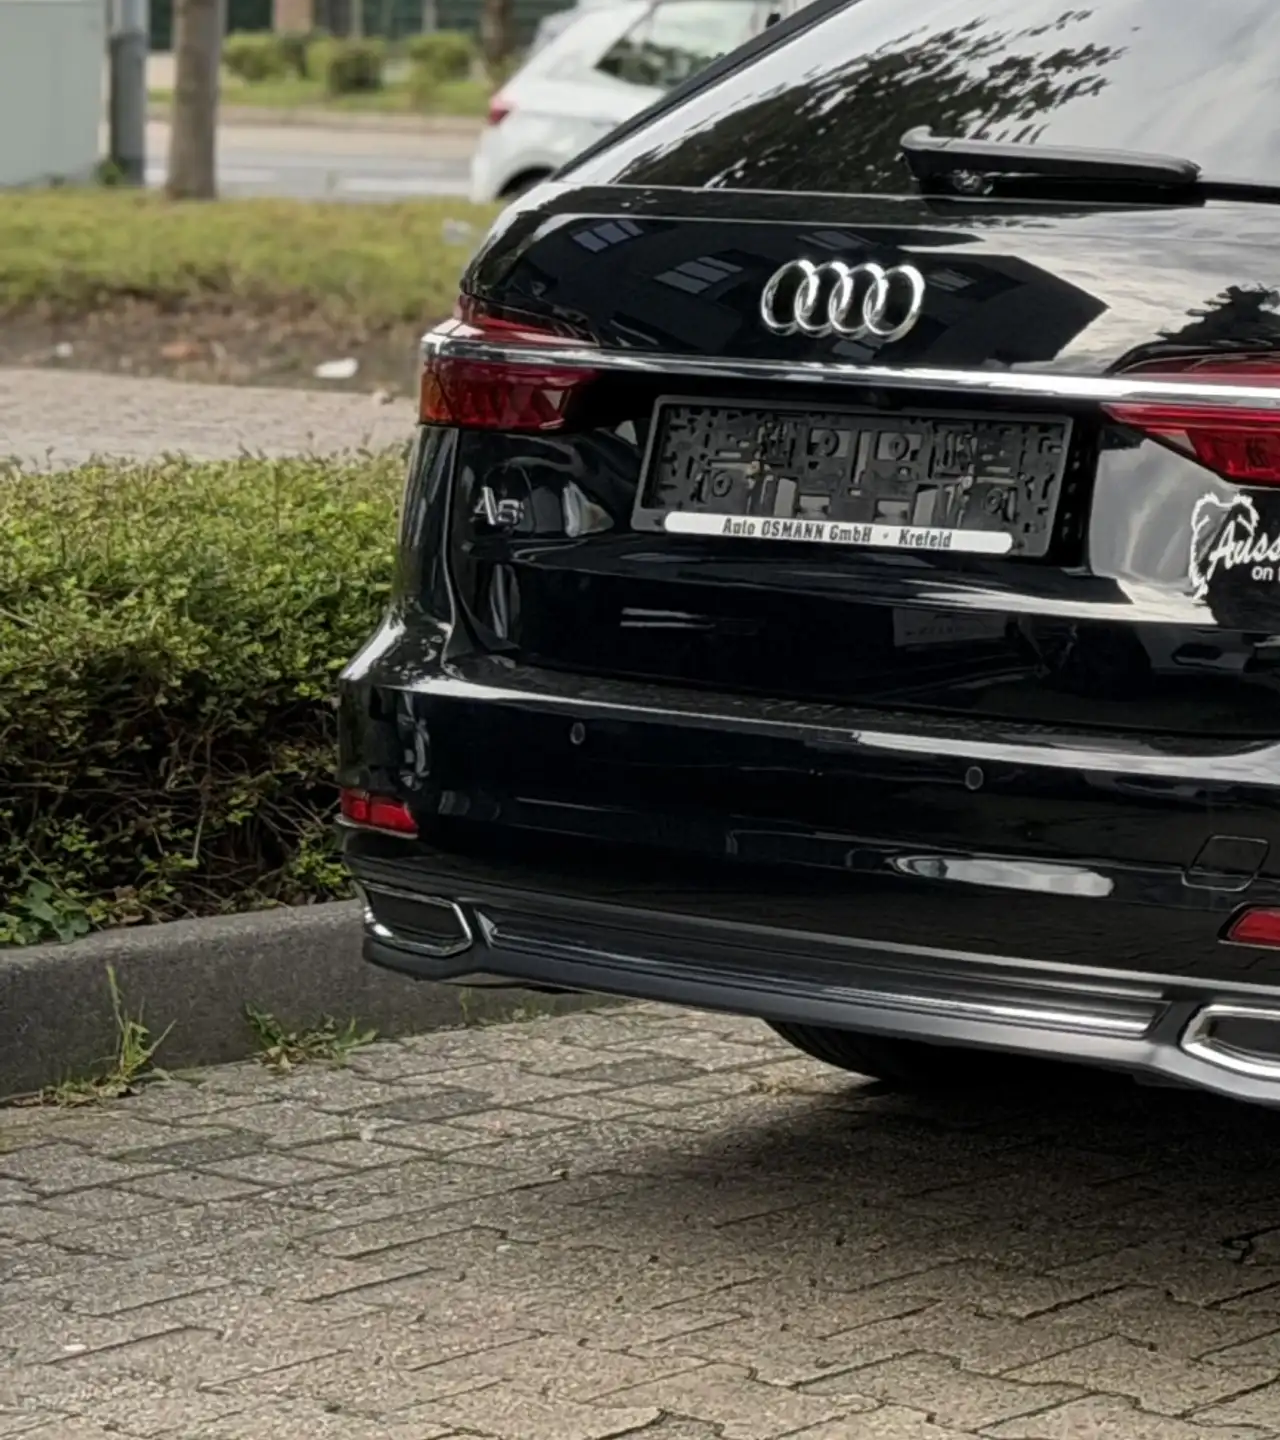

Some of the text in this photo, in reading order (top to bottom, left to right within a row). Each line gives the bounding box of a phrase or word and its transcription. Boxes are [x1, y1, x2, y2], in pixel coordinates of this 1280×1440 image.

[721, 516, 953, 548] Auto OSMANN GmbH Krefeld
[1252, 568, 1273, 582] on
